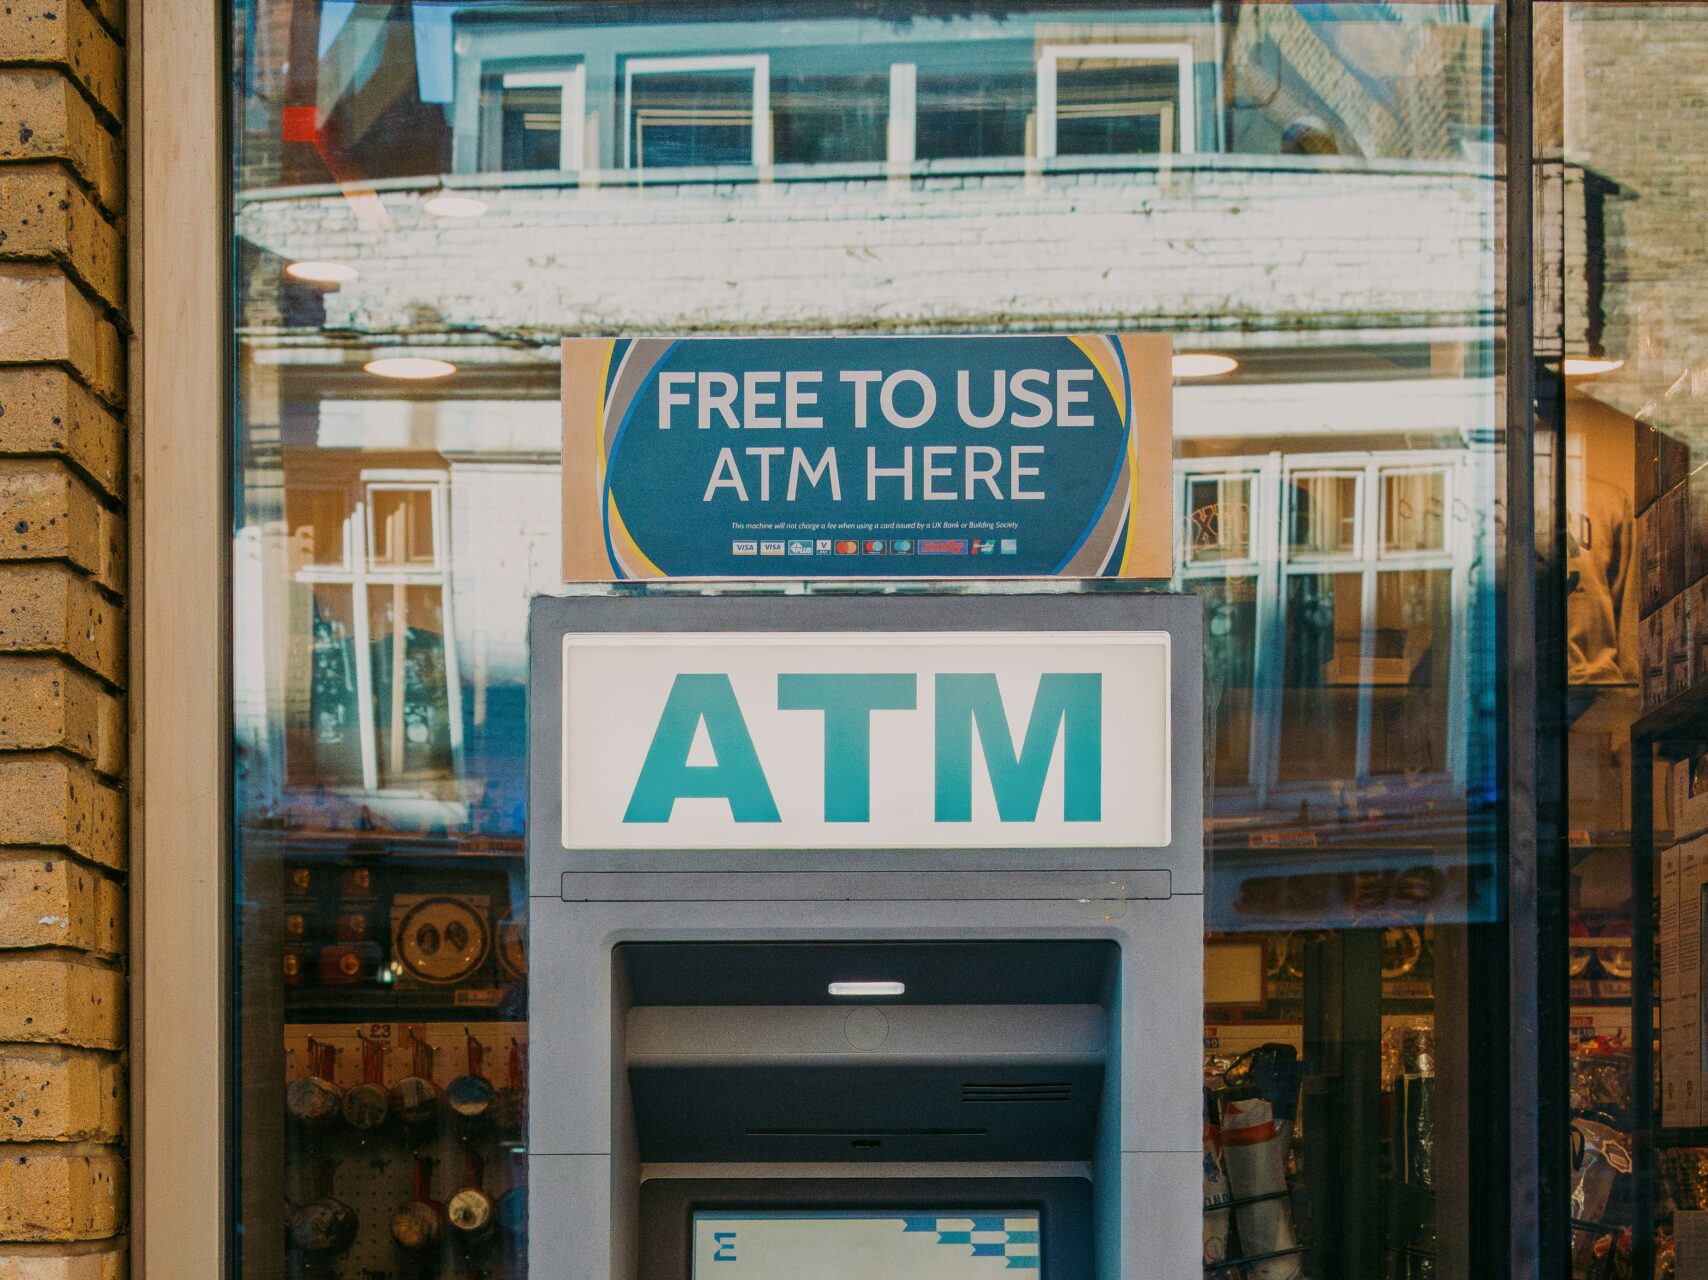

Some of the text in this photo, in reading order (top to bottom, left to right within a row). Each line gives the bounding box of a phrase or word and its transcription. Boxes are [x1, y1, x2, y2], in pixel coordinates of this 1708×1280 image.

[659, 369, 1094, 429] FREE TO USE
[703, 446, 1045, 501] ATM HERE
[798, 522, 820, 530] charge
[856, 522, 873, 530] using
[916, 522, 925, 530] by
[969, 522, 994, 530] Building
[996, 522, 1018, 530] Society
[622, 673, 1102, 823] ATM
[369, 1024, 392, 1038] £3
